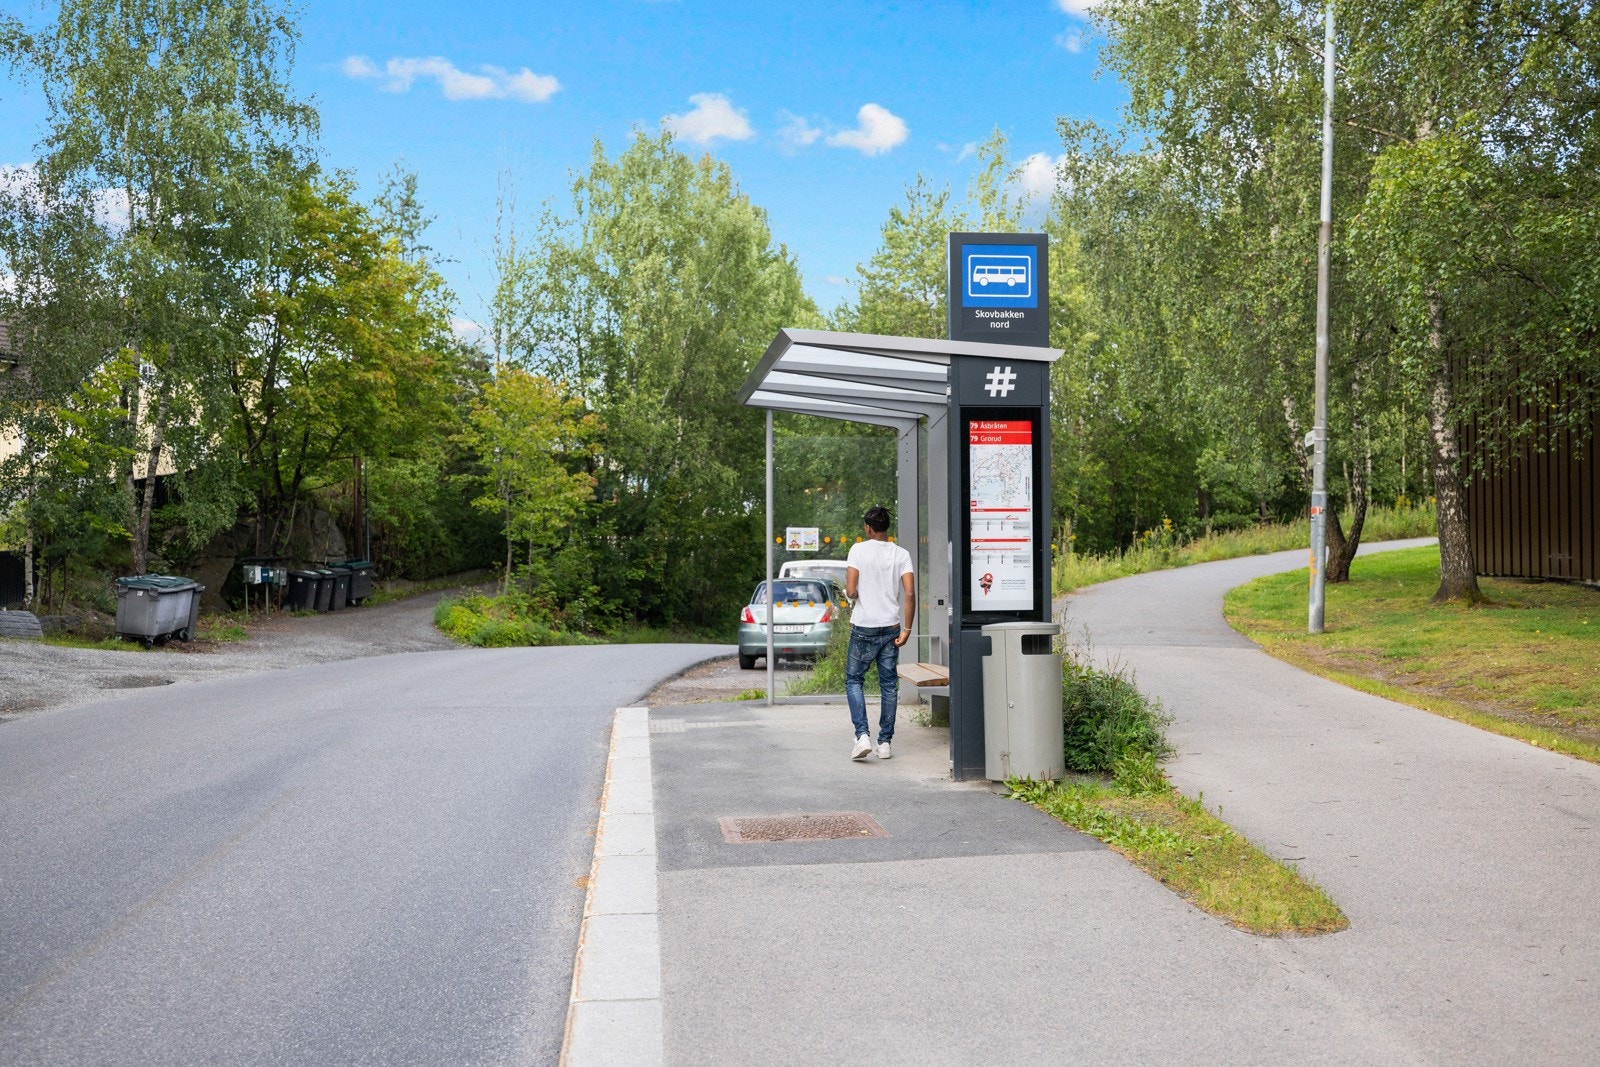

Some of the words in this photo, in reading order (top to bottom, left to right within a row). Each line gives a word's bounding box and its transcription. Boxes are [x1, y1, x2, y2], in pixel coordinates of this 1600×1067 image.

[975, 309, 1025, 319] Skovbakken
[990, 320, 1010, 329] nord
[980, 421, 1008, 430] Åsbråten
